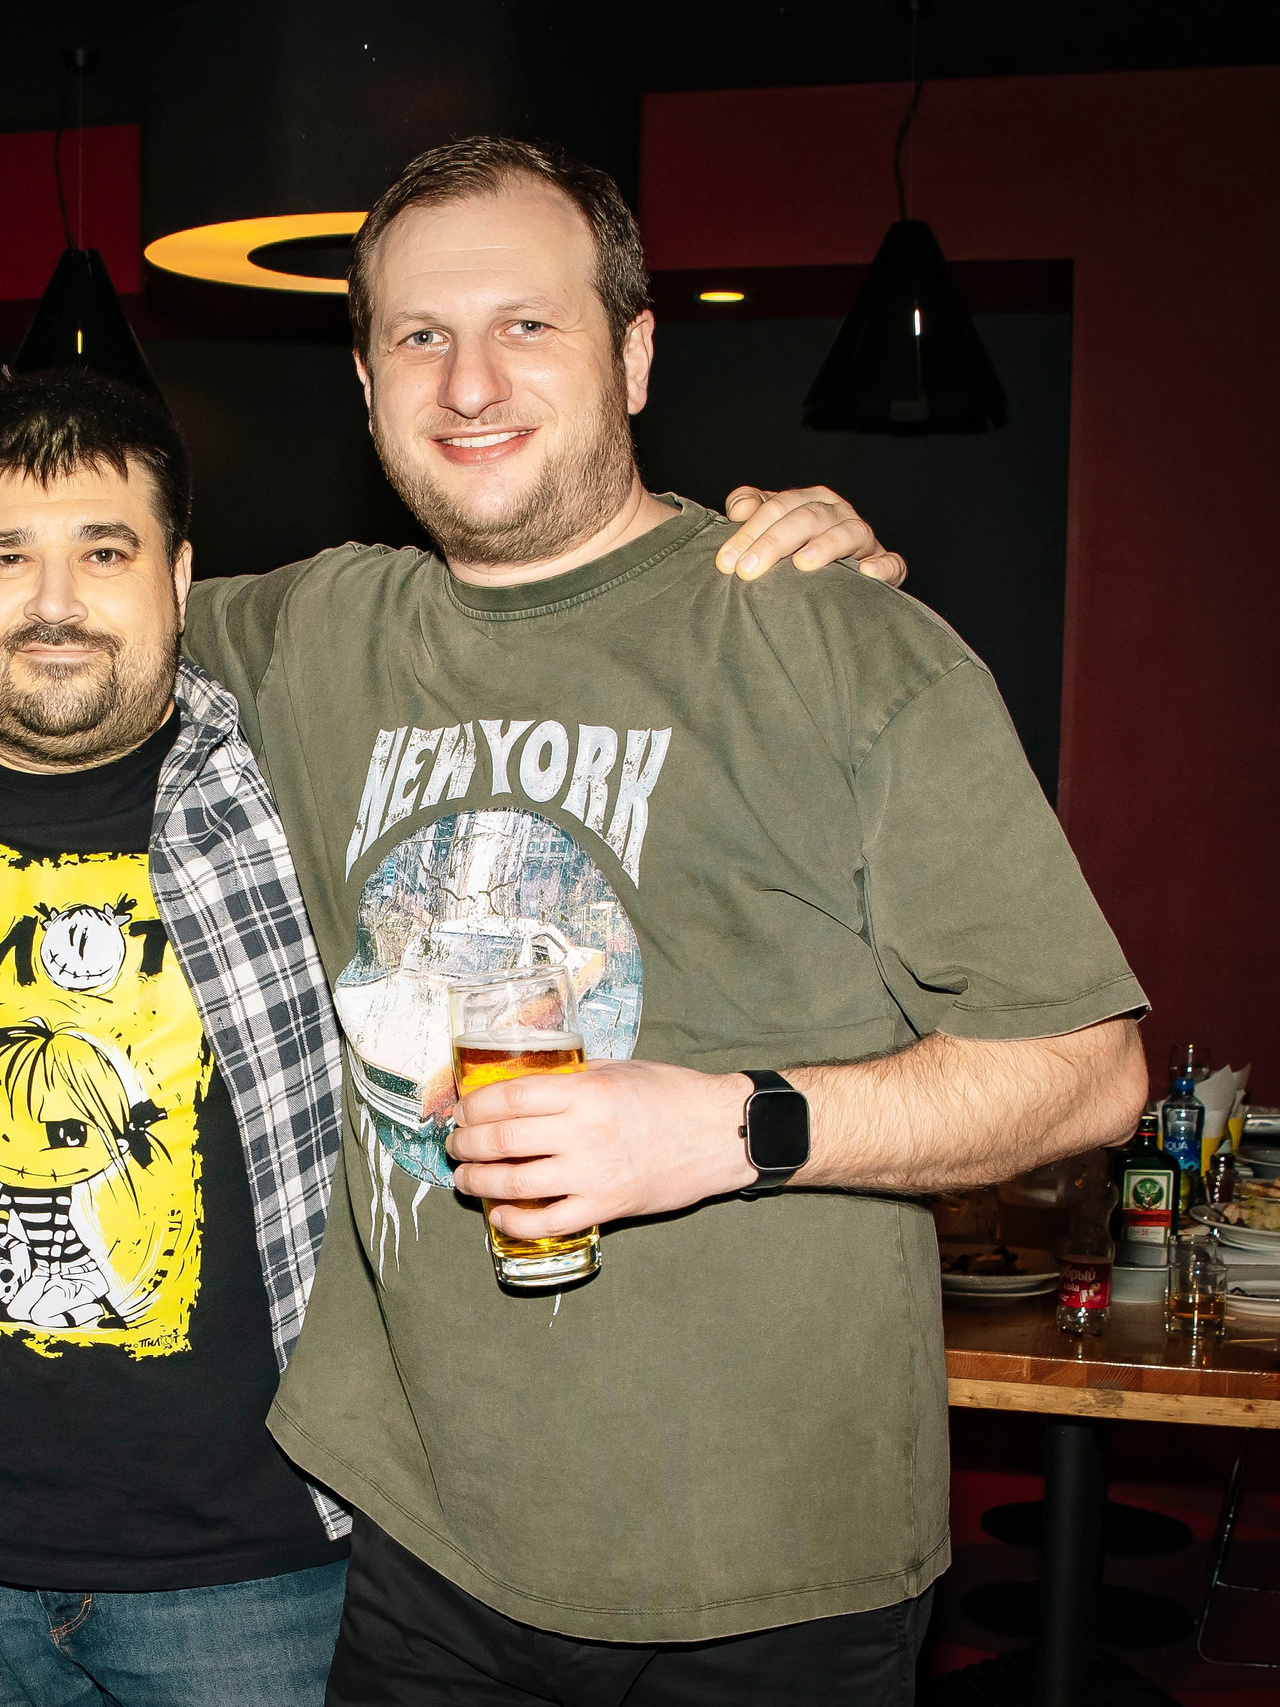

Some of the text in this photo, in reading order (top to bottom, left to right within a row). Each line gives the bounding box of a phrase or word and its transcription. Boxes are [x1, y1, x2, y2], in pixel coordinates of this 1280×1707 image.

[345, 719, 672, 889] NEW YORK
[1164, 1141, 1188, 1151] QUA
